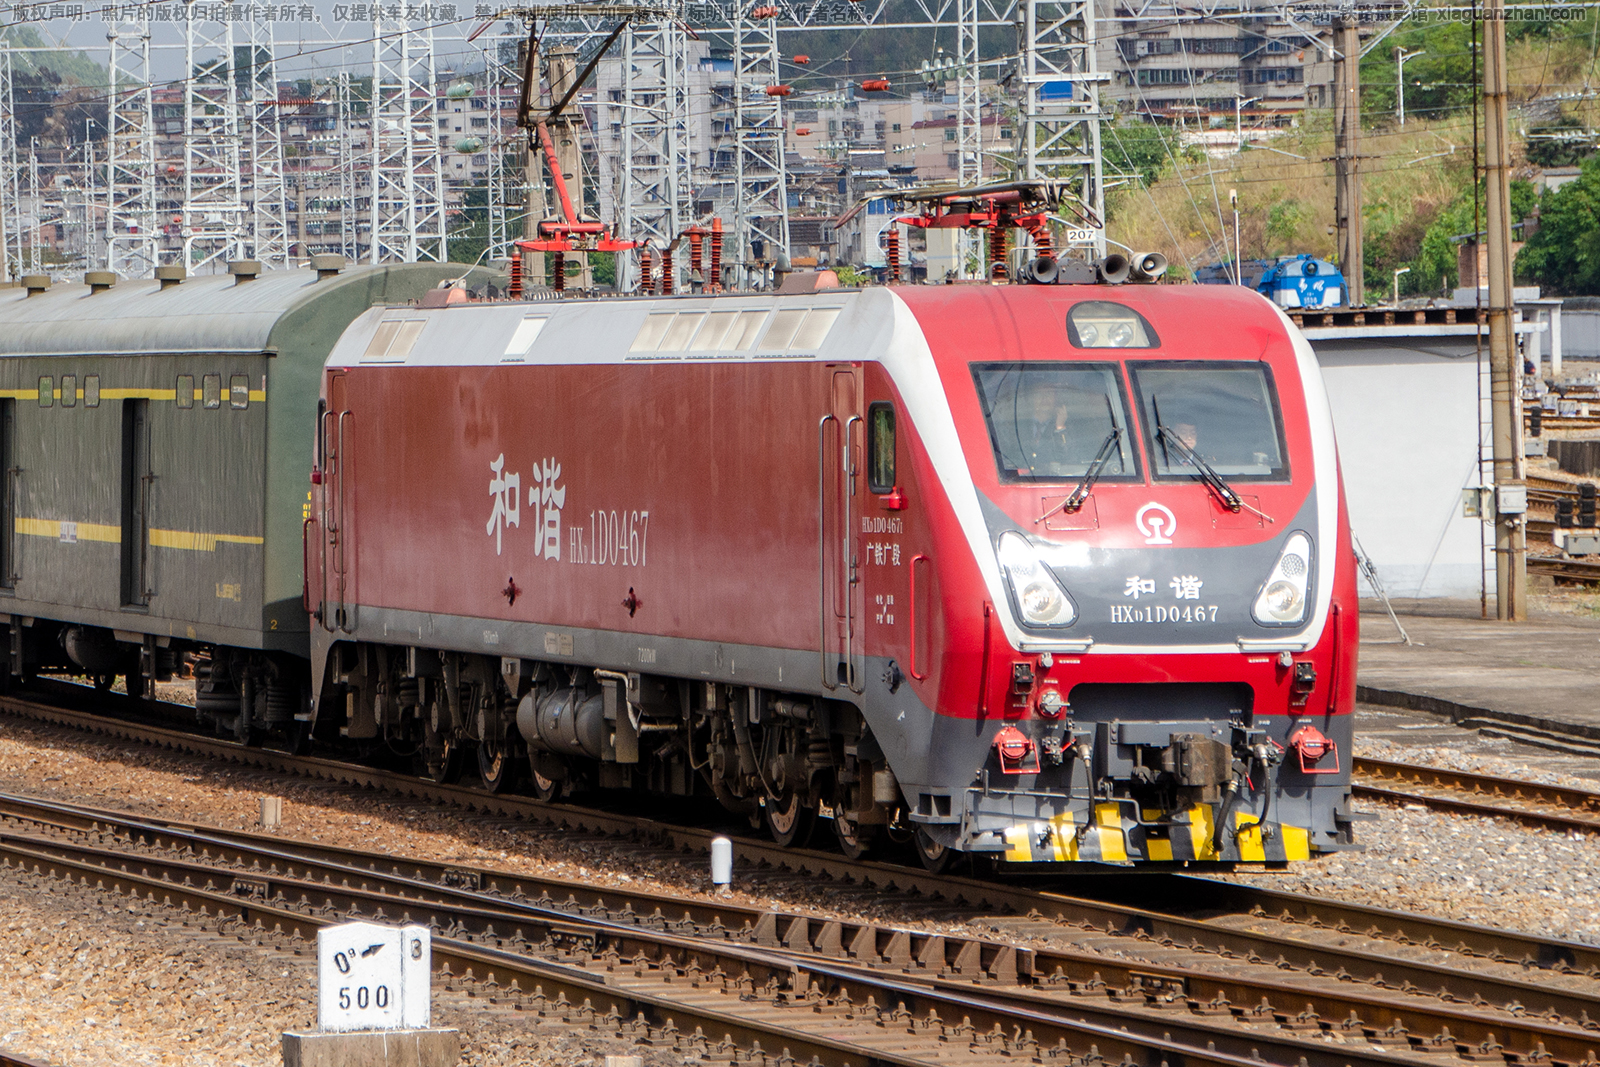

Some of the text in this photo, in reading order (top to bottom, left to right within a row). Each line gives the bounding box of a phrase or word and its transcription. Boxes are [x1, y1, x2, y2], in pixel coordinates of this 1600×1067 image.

[1069, 230, 1094, 240] 207
[486, 452, 566, 562] 和谐
[866, 542, 901, 566] 广铁广段
[1123, 575, 1203, 600] 和谐
[270, 619, 278, 631] 2
[339, 985, 389, 1010] 500
